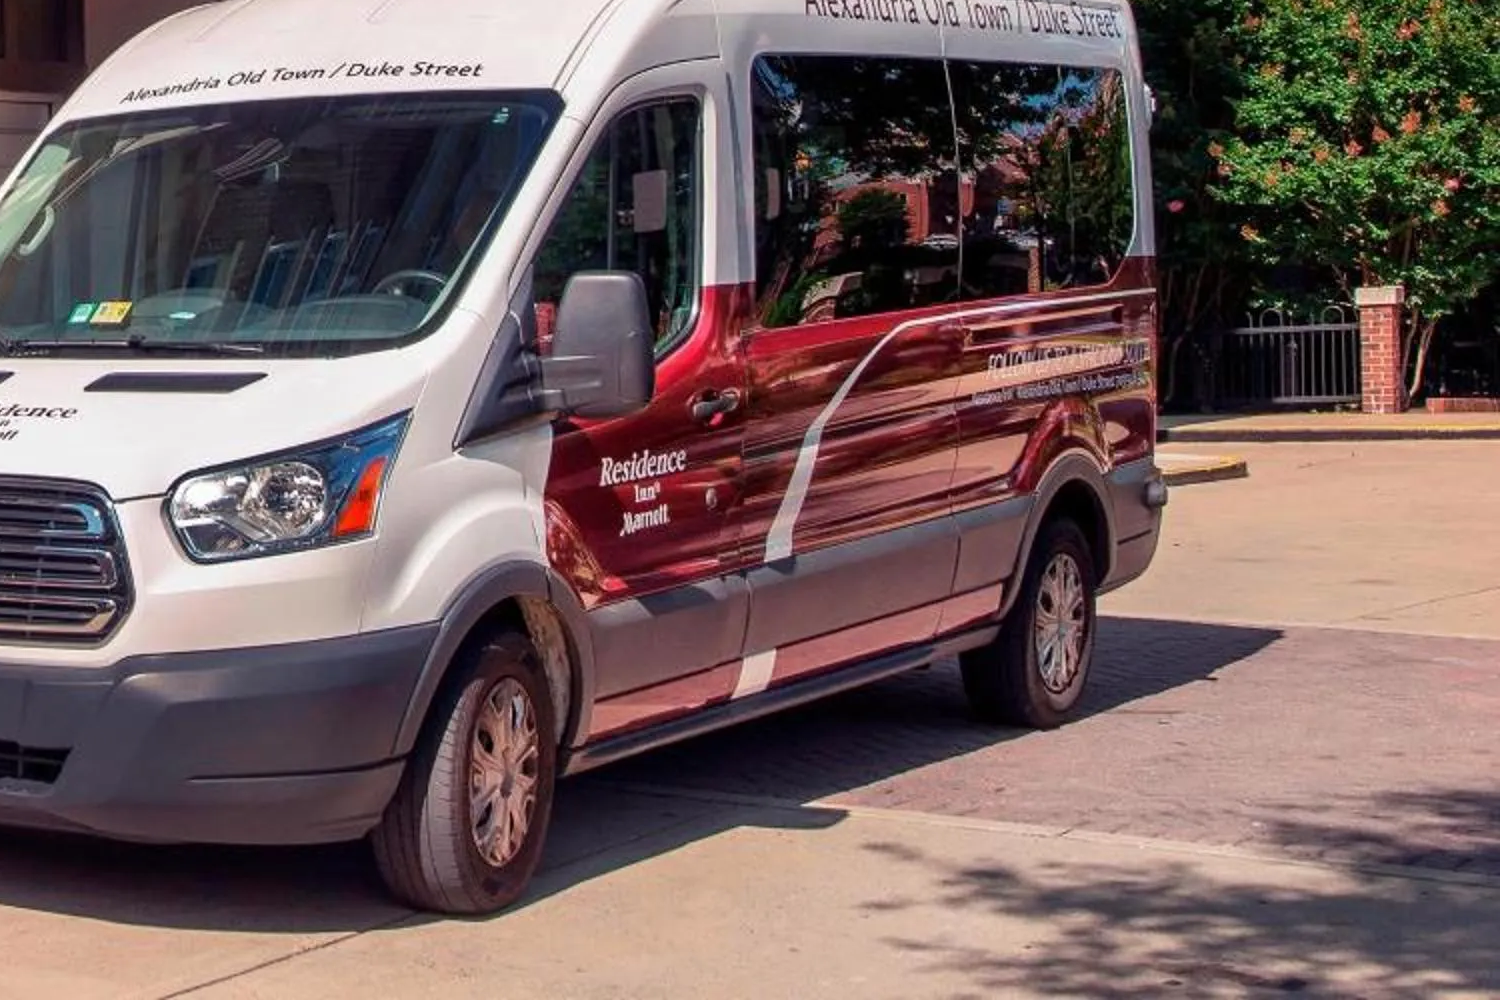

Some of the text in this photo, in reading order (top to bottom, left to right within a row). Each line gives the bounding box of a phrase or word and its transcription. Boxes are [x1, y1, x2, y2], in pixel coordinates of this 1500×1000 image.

[1071, 0, 1122, 39] Street
[119, 76, 221, 105] Alexandria
[227, 69, 267, 87] Old
[272, 66, 326, 80] Town
[346, 61, 404, 77] Duke
[409, 61, 484, 78] Street
[599, 448, 687, 487] Residence
[620, 503, 669, 537] Marriott
